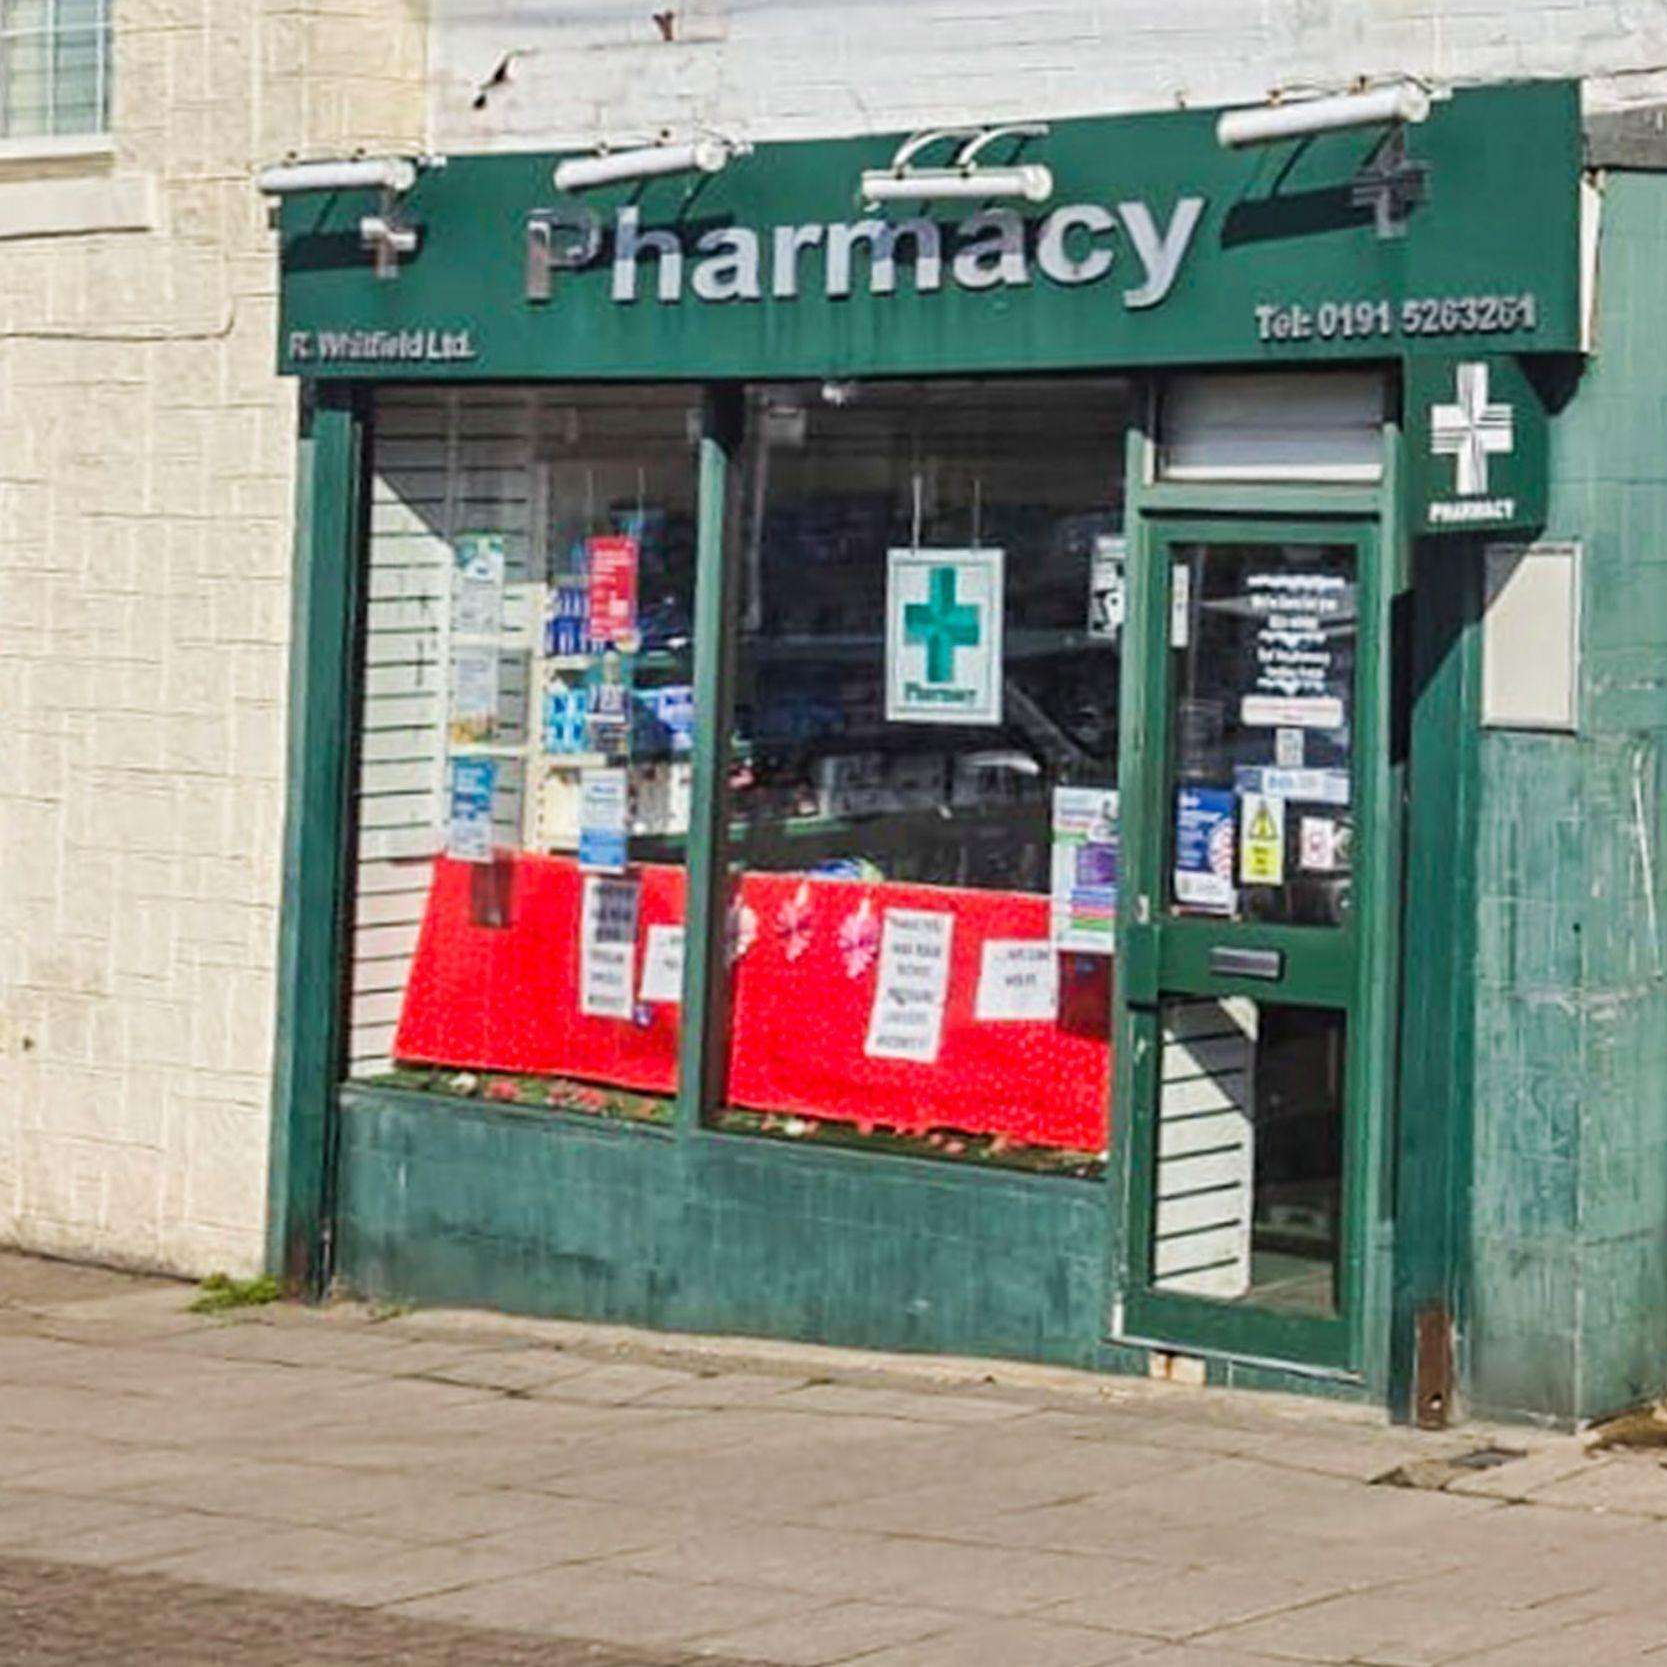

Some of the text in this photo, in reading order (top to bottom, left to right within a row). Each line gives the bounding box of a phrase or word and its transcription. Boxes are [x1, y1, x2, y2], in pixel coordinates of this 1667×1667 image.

[525, 195, 1206, 310] Pharmacy
[1255, 304, 1313, 340] Tel:
[1318, 300, 1392, 337] 0191
